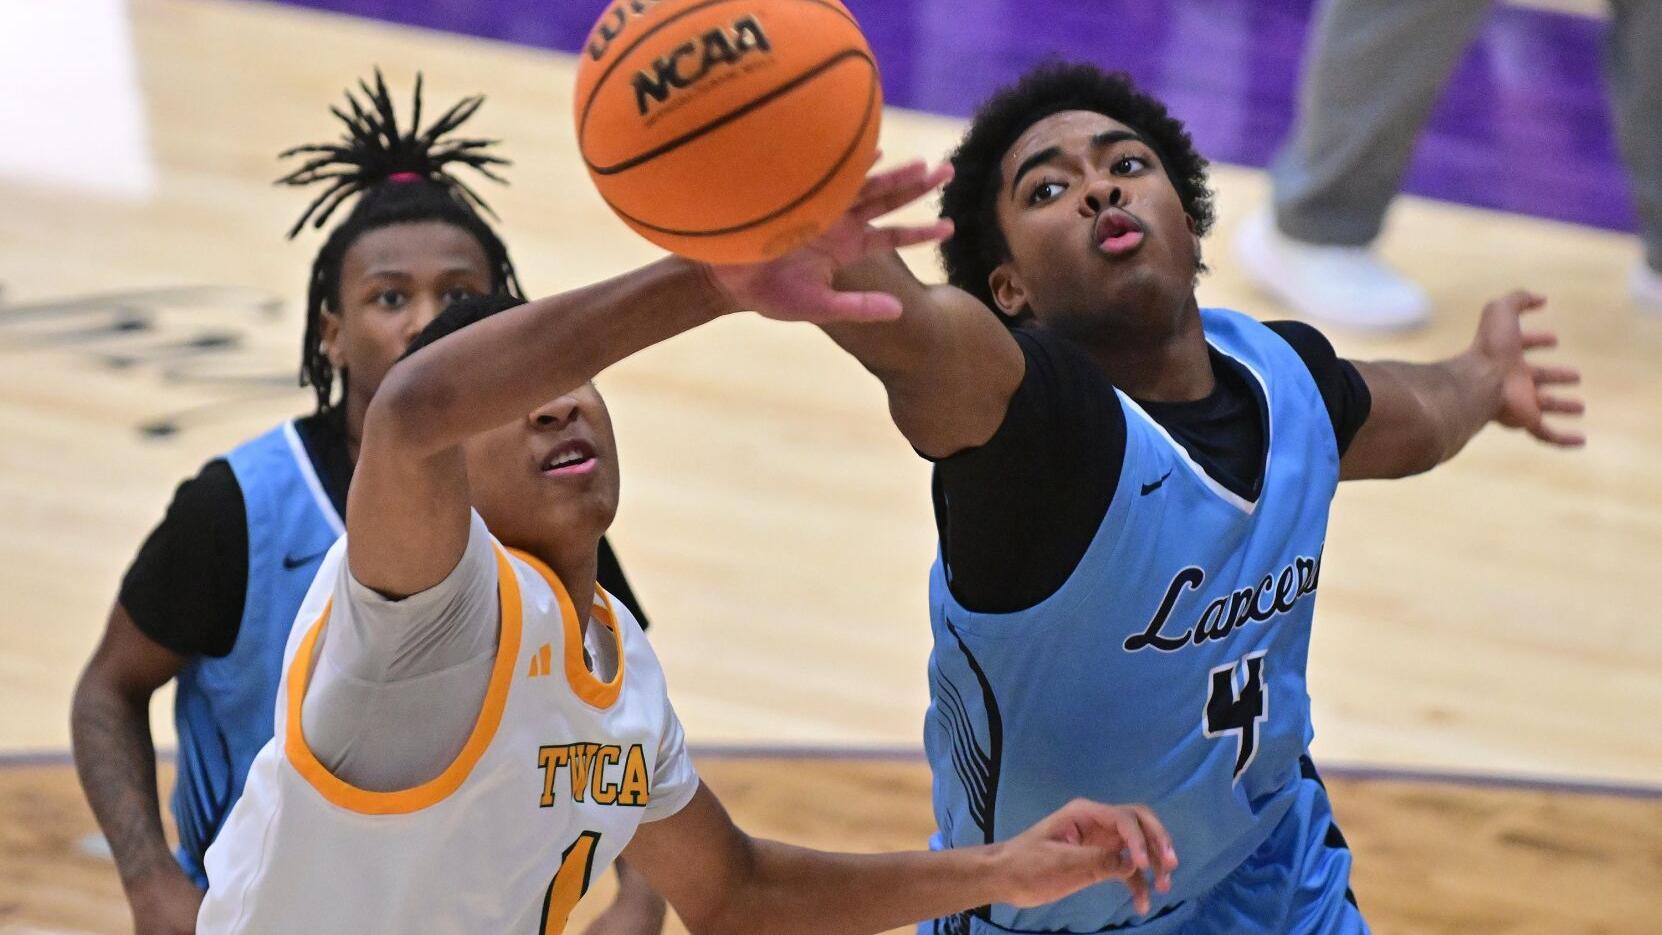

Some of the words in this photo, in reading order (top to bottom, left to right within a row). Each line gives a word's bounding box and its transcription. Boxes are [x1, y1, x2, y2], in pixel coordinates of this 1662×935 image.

[631, 14, 771, 116] NCAA
[1202, 649, 1269, 790] 4
[538, 741, 650, 808] TWCA
